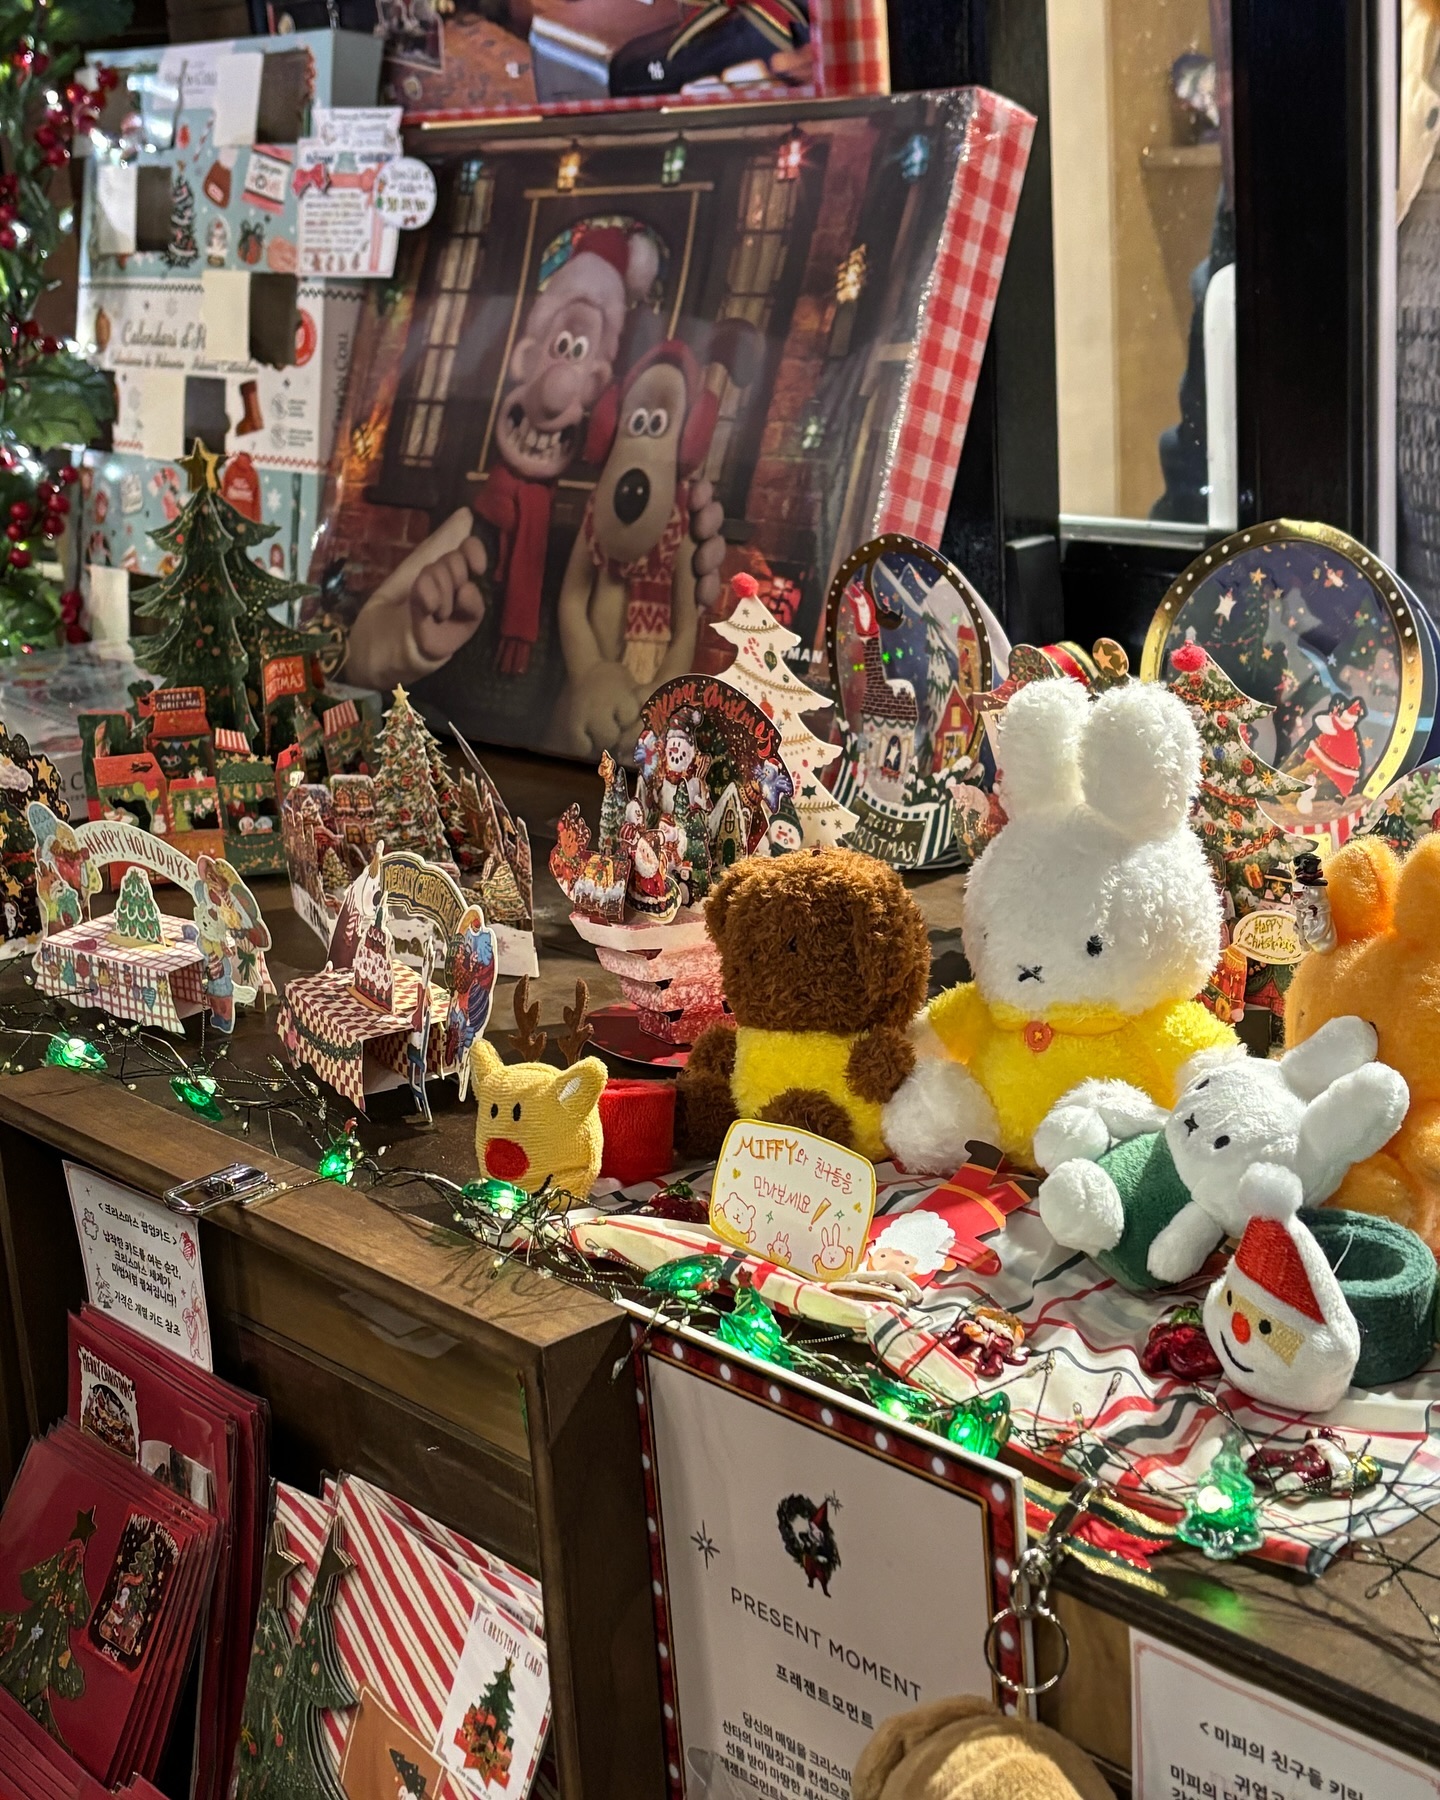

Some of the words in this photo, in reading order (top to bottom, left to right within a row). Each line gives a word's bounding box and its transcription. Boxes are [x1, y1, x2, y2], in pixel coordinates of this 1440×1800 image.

[83, 829, 126, 855] HAPPY
[384, 864, 418, 899] MERRY
[814, 1157, 853, 1195] 친구들을
[105, 1203, 140, 1229] 크리스마스
[141, 1220, 171, 1244] 팝업카드
[111, 1262, 138, 1287] 마법처럼
[114, 1250, 148, 1276] 크리스마스
[125, 1241, 146, 1263] 카드를
[114, 1290, 133, 1311] 가격은
[149, 1311, 164, 1328] 카드
[165, 1318, 181, 1337] 참조
[482, 1617, 521, 1659] CHRISTMAS
[524, 1651, 543, 1677] CARD
[731, 1586, 821, 1650] PRESENT
[829, 1638, 922, 1702] MOMENT
[776, 1663, 874, 1730] 프레젠트모먼트
[722, 1719, 752, 1748] 산타의
[754, 1738, 805, 1780] 비밀창고를
[743, 1711, 774, 1742] 당신의
[775, 1730, 807, 1761] 매일을
[1214, 1726, 1265, 1763] 미피의
[1271, 1751, 1324, 1790] 친구들
[726, 1740, 745, 1763] 선물
[747, 1752, 768, 1777] 받아
[769, 1766, 801, 1797] 마땅한
